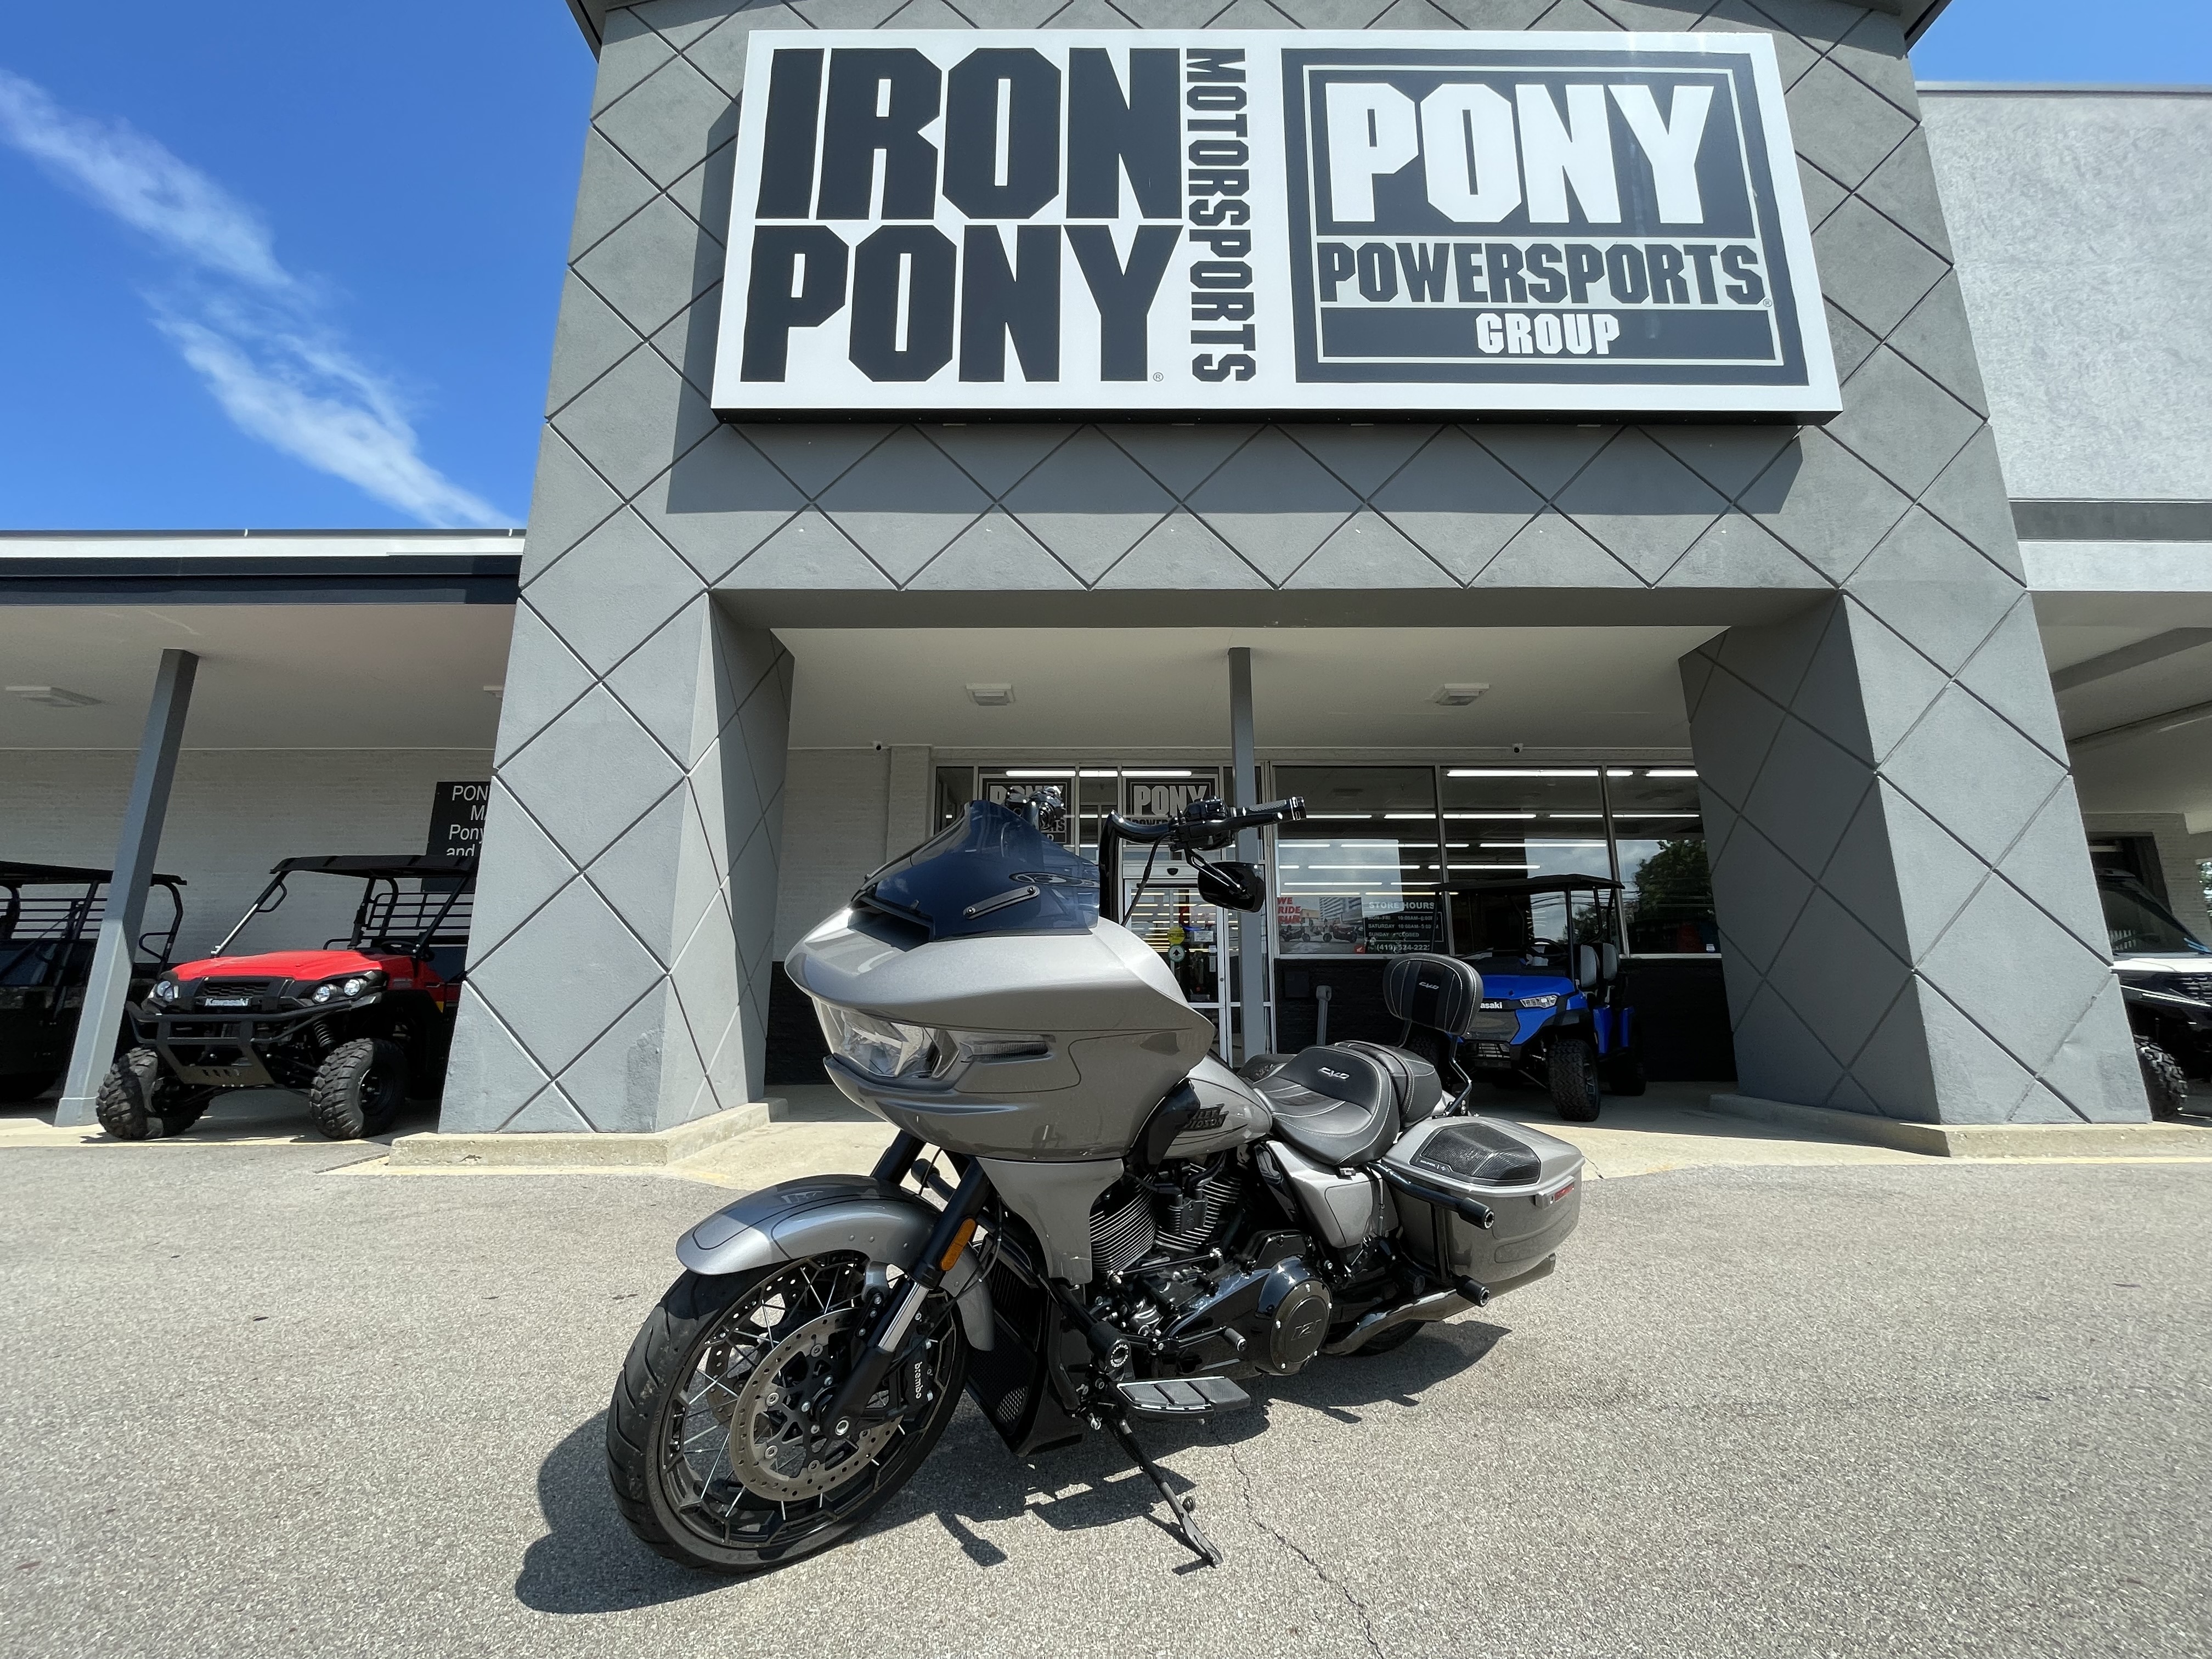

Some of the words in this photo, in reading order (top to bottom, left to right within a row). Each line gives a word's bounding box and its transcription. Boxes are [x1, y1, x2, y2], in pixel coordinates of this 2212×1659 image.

[755, 48, 1182, 219] IRON
[1325, 82, 1714, 224] PONY
[1186, 48, 1256, 382] MOTORSPORTS
[1317, 241, 1766, 305] POWERSPORTS
[740, 224, 1184, 382] PONY
[1475, 312, 1621, 355] GROUP
[452, 785, 489, 801] PON
[446, 844, 475, 856] and
[1278, 906, 1301, 914] RIDE
[914, 1361, 924, 1399] brembo
